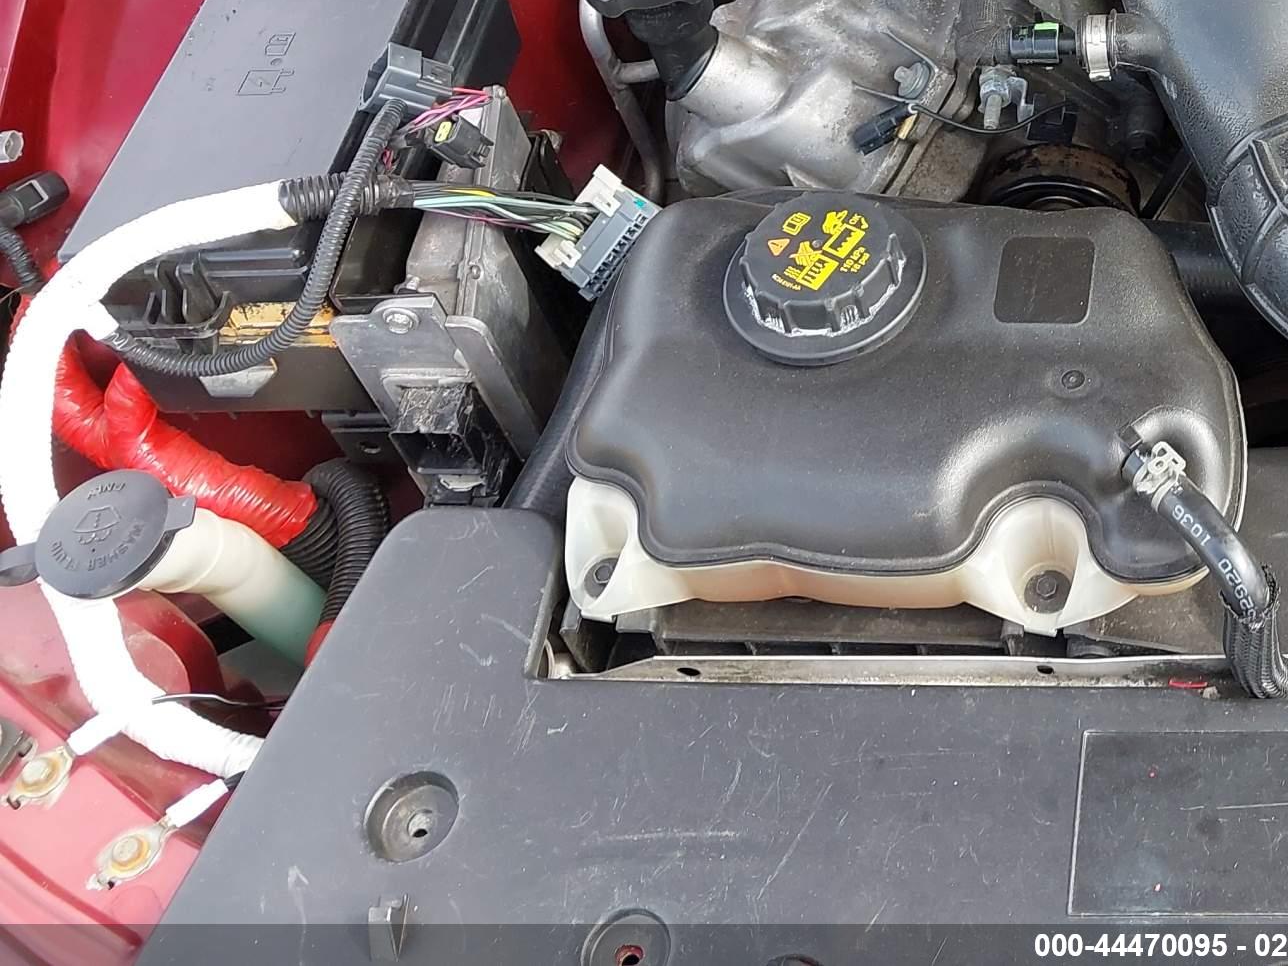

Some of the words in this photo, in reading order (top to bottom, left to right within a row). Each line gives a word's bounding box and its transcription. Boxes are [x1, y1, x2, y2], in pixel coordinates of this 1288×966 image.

[848, 213, 863, 225] OK
[840, 257, 854, 273] 110
[1171, 504, 1212, 547] 1036
